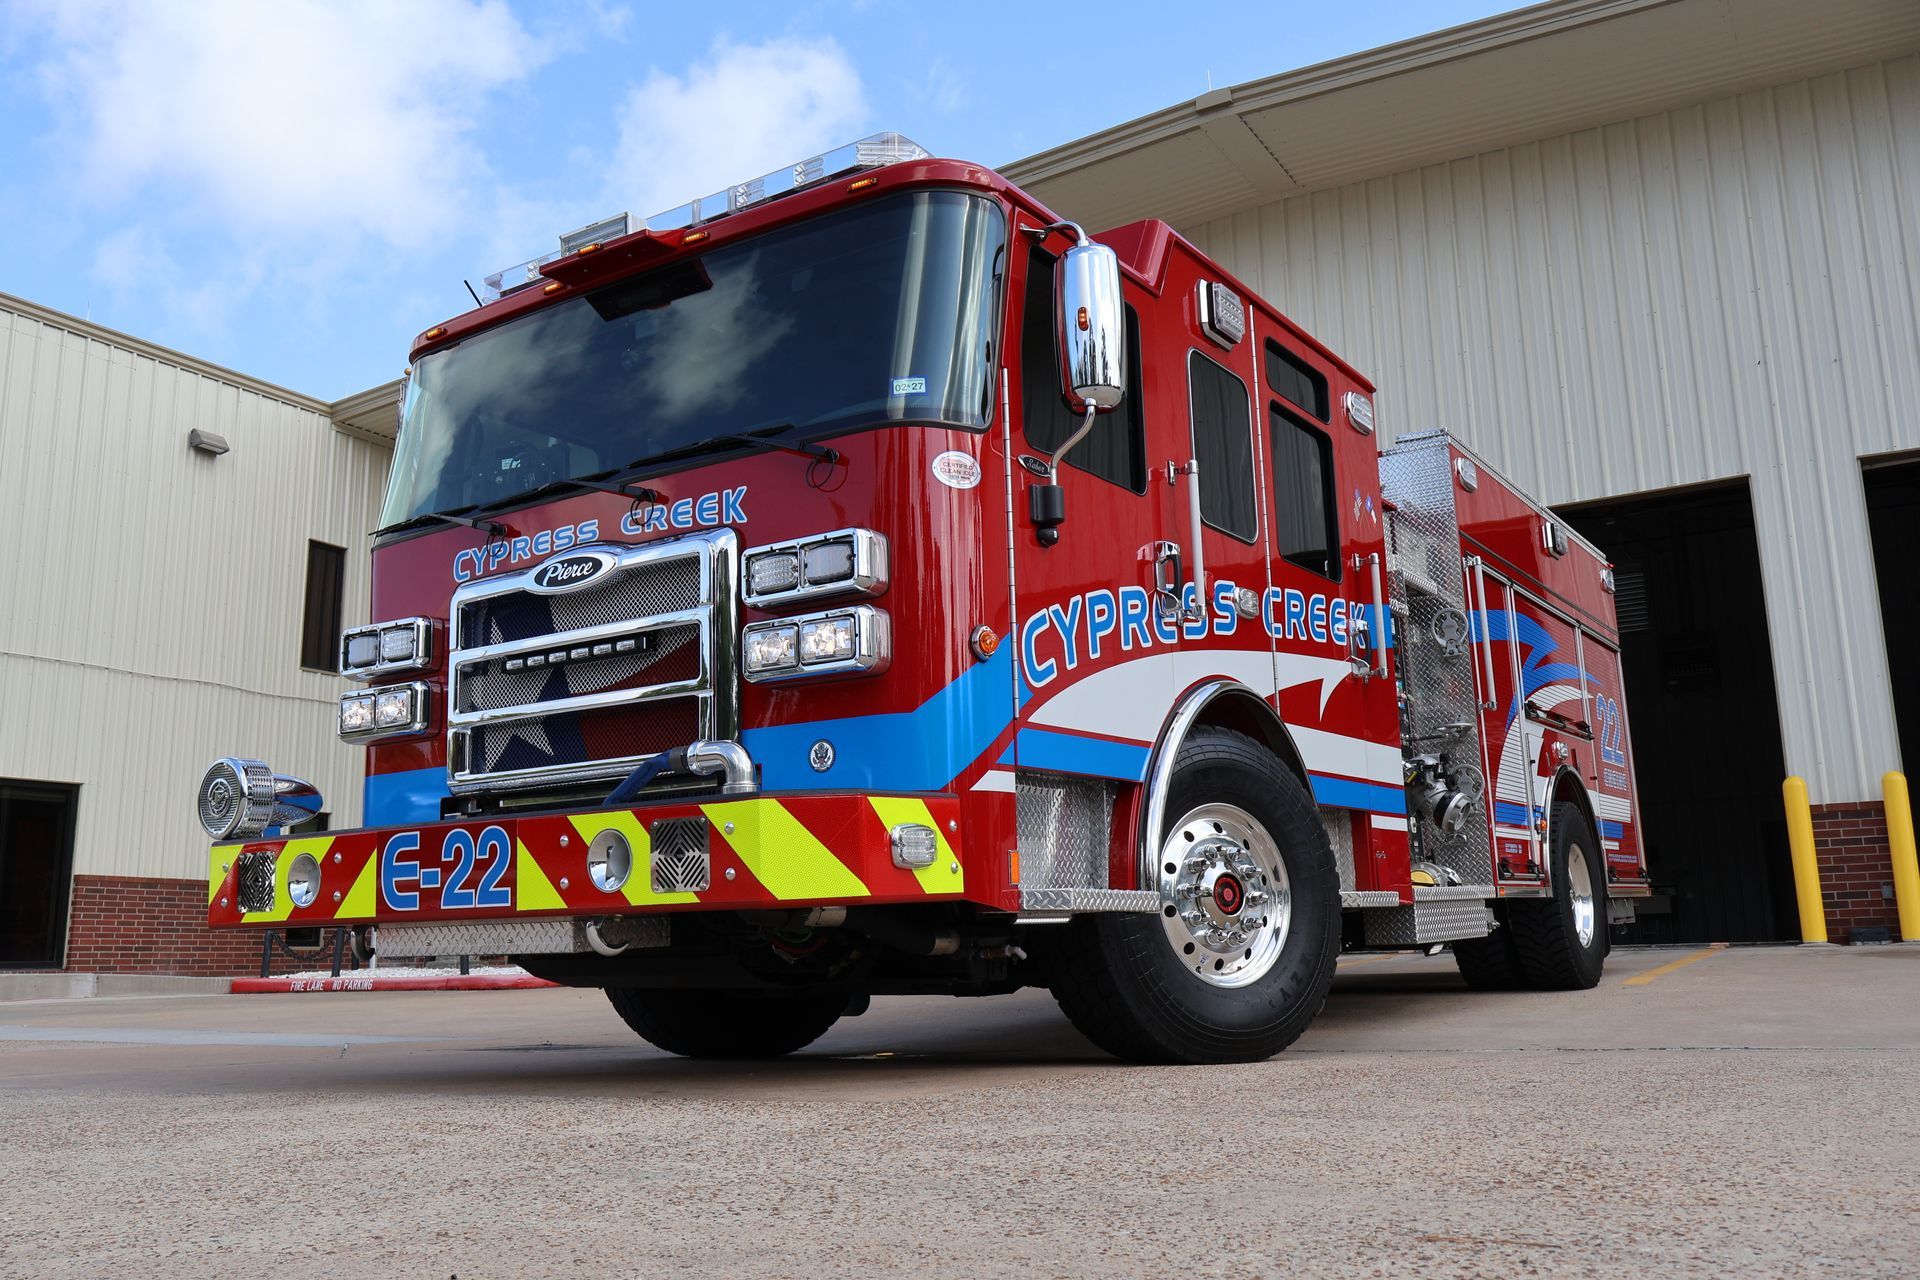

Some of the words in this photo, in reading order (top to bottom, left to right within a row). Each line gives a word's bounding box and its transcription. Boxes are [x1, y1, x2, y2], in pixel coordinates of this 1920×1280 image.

[912, 382, 923, 390] 27
[940, 467, 961, 475] CLEAN
[453, 519, 599, 582] CYPRESS
[620, 486, 747, 535] CREEK
[542, 561, 594, 587] Pierce
[1021, 579, 1238, 688] CYPRESS
[1262, 586, 1366, 649] CREEK
[1596, 693, 1625, 767] 22
[381, 825, 511, 911] E-22
[290, 981, 306, 991] FIRE
[306, 980, 325, 991] LANE
[332, 979, 342, 991] NO
[343, 979, 374, 991] PARKING
